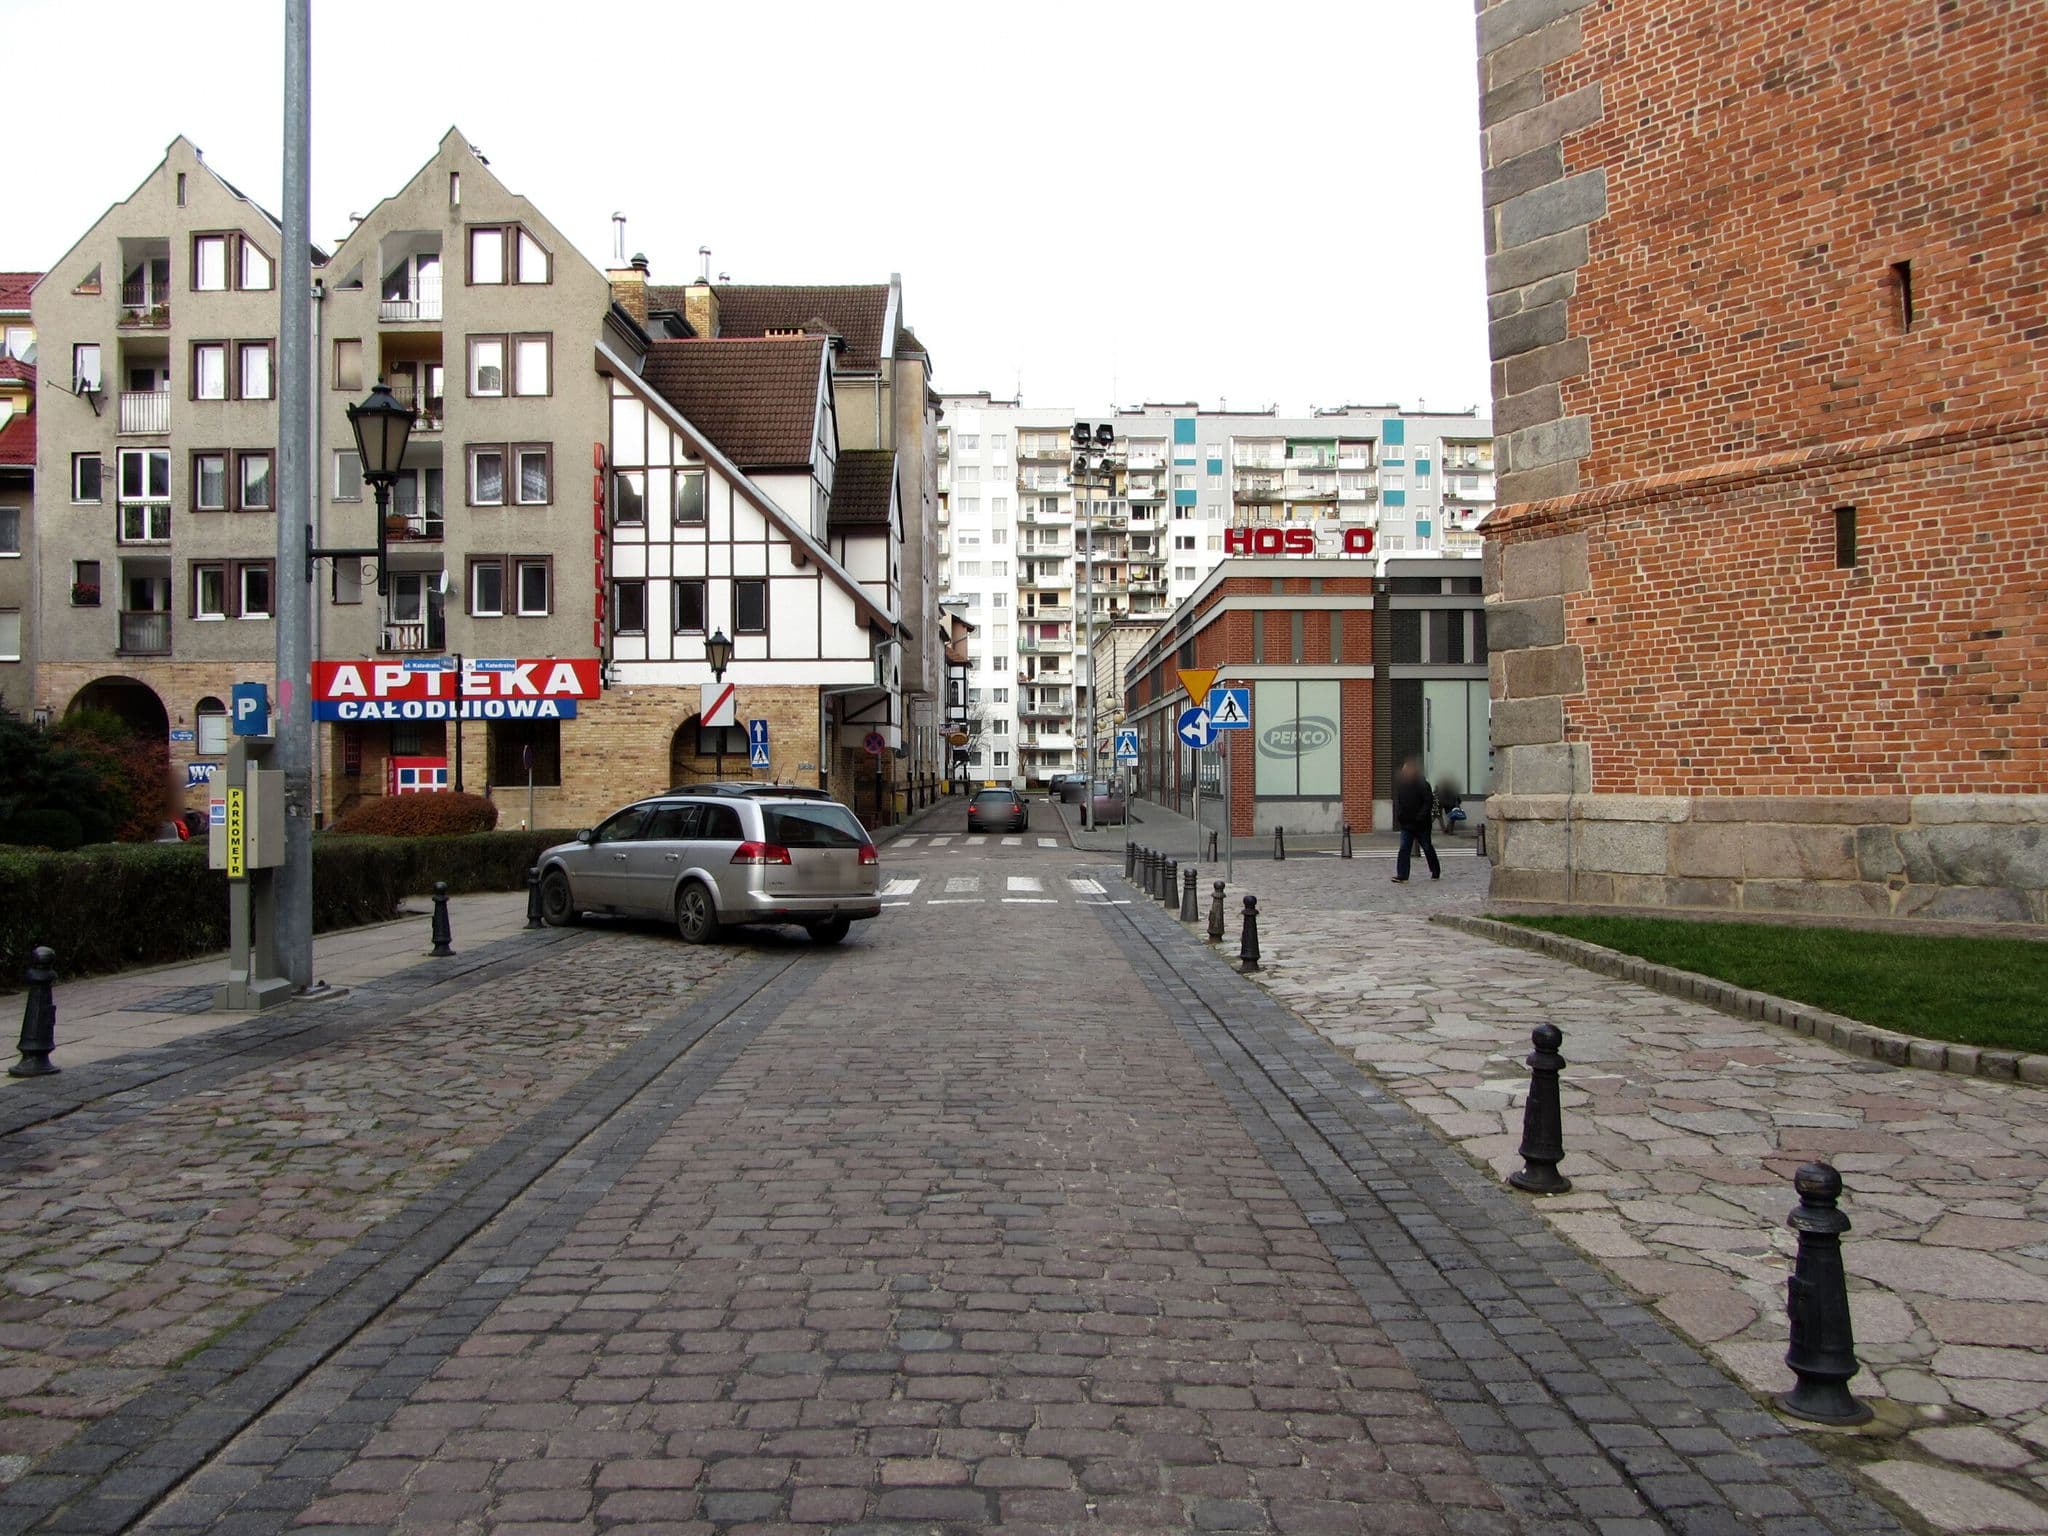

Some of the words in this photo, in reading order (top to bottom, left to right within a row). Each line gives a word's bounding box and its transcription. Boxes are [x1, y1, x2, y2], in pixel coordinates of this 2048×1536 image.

[1224, 519, 1374, 554] HOSSO
[327, 663, 584, 697] APTEKA
[238, 698, 257, 721] P
[337, 700, 560, 719] CAŁODNIOWA
[1270, 731, 1326, 745] PEPCO
[231, 790, 240, 874] PARKOMETR
